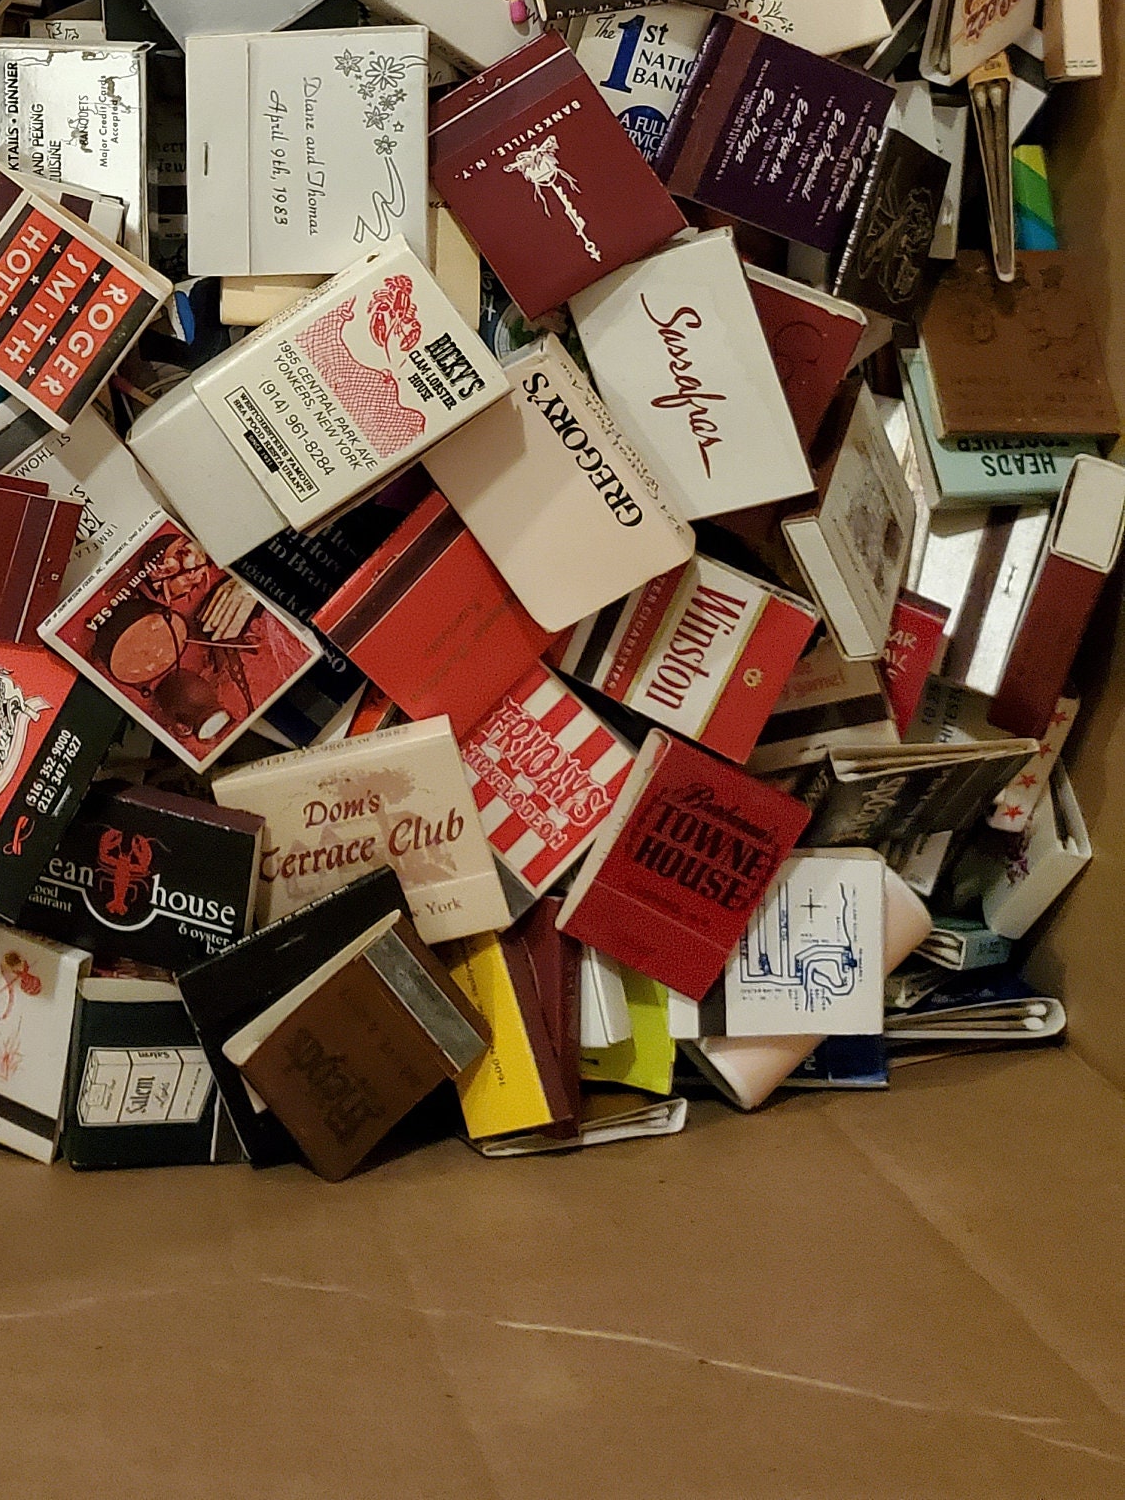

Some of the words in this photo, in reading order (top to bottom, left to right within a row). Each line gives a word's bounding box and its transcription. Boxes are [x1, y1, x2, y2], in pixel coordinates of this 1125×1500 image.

[594, 17, 617, 41] The
[600, 15, 670, 94] 1st
[1, 60, 22, 114] DINNER
[28, 102, 46, 147] PEKING
[95, 102, 110, 136] Credit
[263, 89, 289, 143] April
[489, 100, 583, 158] BANKSVILLE,
[31, 148, 46, 176] AND
[96, 138, 112, 168] Major
[271, 185, 289, 227] 1983
[306, 168, 326, 237] Thomas
[40, 282, 129, 397] ROGER
[270, 352, 318, 412] YONKERS,
[312, 408, 338, 438] NEW
[331, 433, 363, 472] YORK
[275, 336, 302, 367] 1955
[294, 362, 339, 418] CENTRAL
[331, 413, 361, 448] PARK
[408, 374, 435, 403] HOUSE
[641, 292, 727, 479] Sassafras
[256, 376, 292, 417] (914)
[282, 411, 336, 479] 961-8284
[522, 371, 644, 527] GREGORY'S
[982, 451, 1057, 477] HEADS
[85, 608, 114, 632] SEA
[109, 586, 133, 611] the
[645, 583, 748, 710] Winston
[26, 779, 47, 807] (516)
[40, 730, 72, 781] 352-9000
[37, 786, 57, 814] (212)
[51, 736, 83, 789] 347-7627
[455, 737, 570, 853] NICKELODEON
[302, 793, 381, 829] Dom's
[259, 836, 377, 885] Terrace
[389, 807, 464, 856] Club
[652, 805, 768, 880] TOWNE
[149, 874, 237, 926] house
[631, 835, 745, 909] HOUSE
[426, 898, 462, 917] York
[190, 926, 231, 948] oyster
